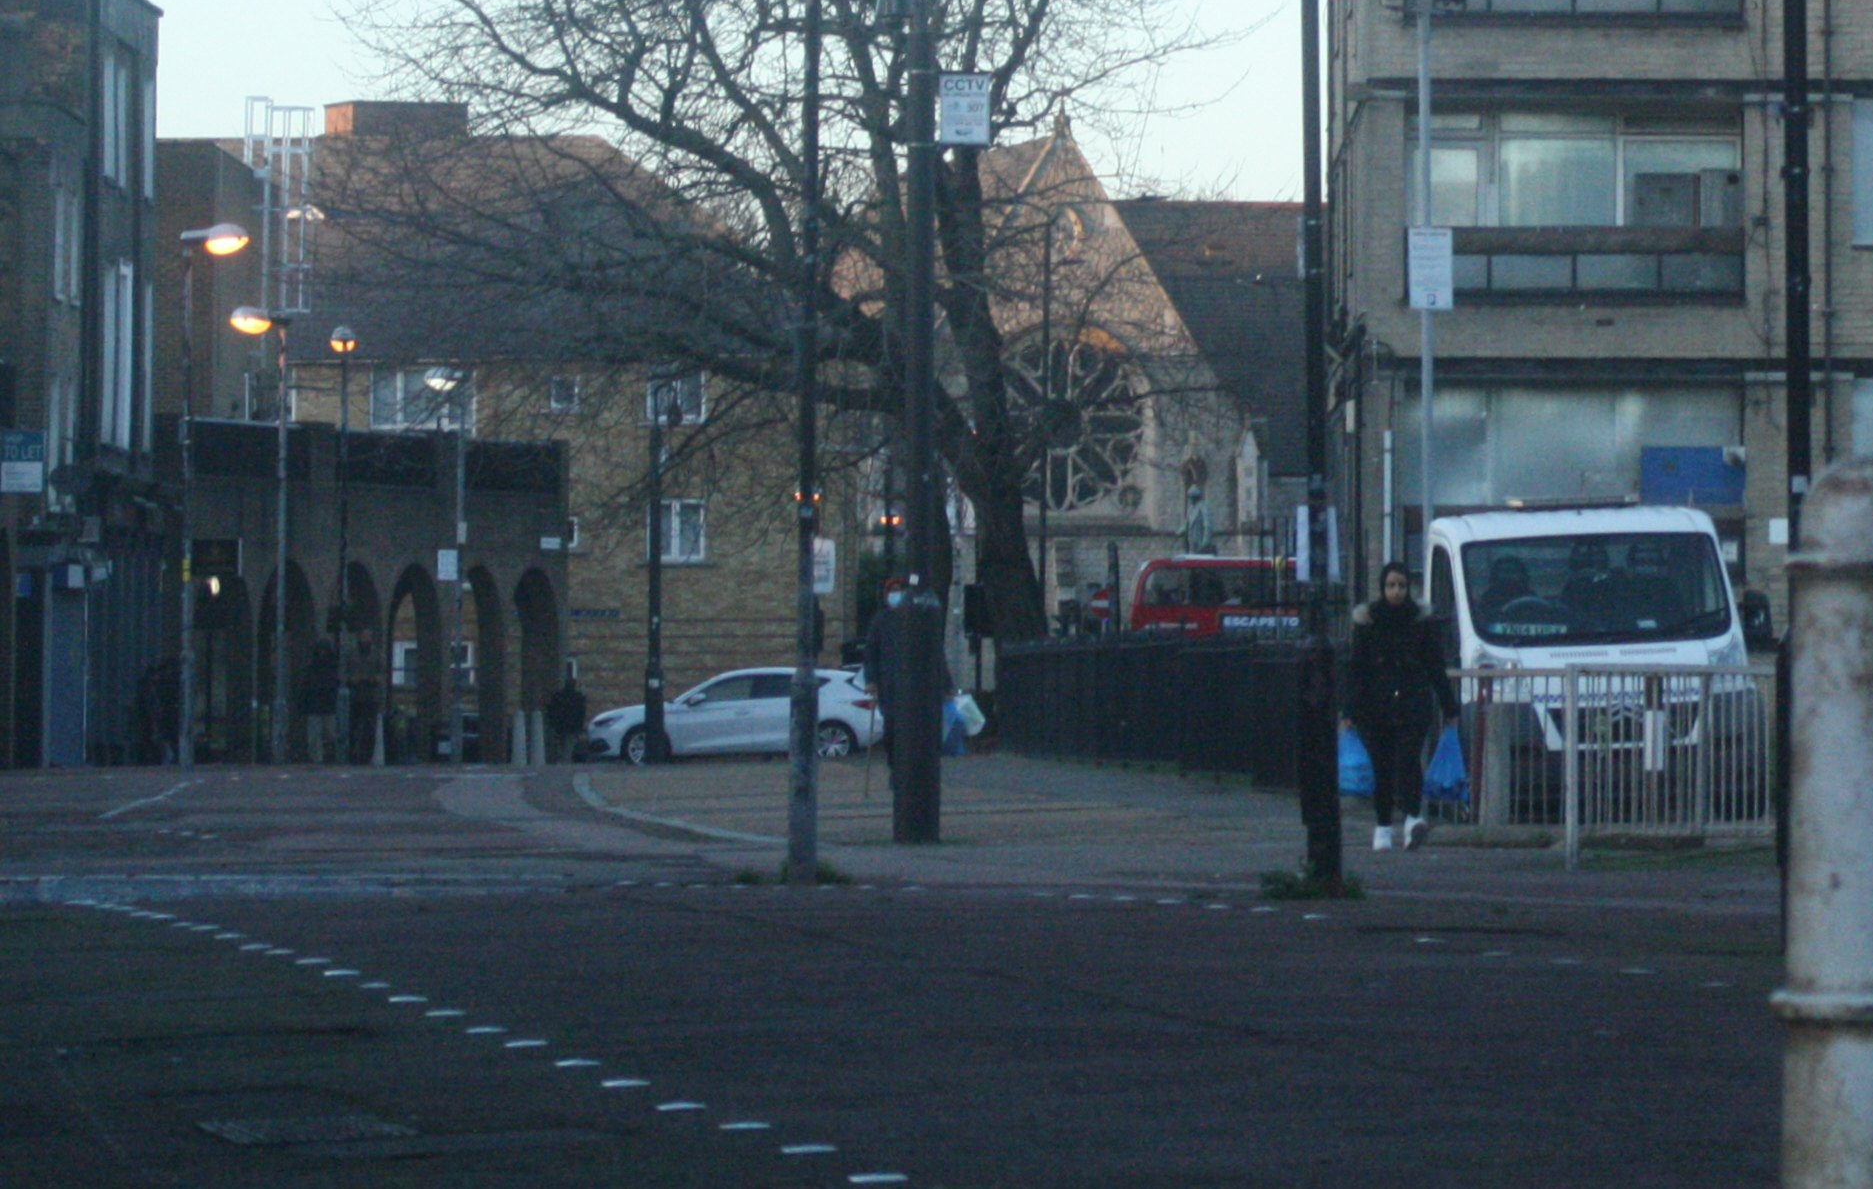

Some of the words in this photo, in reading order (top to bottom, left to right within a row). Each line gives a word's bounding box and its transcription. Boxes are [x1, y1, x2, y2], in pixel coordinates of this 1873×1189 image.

[943, 78, 985, 91] CCTV
[4, 444, 19, 460] TO
[21, 444, 42, 460] LET
[1223, 615, 1276, 628] ESCAPE
[1281, 615, 1299, 627] TO
